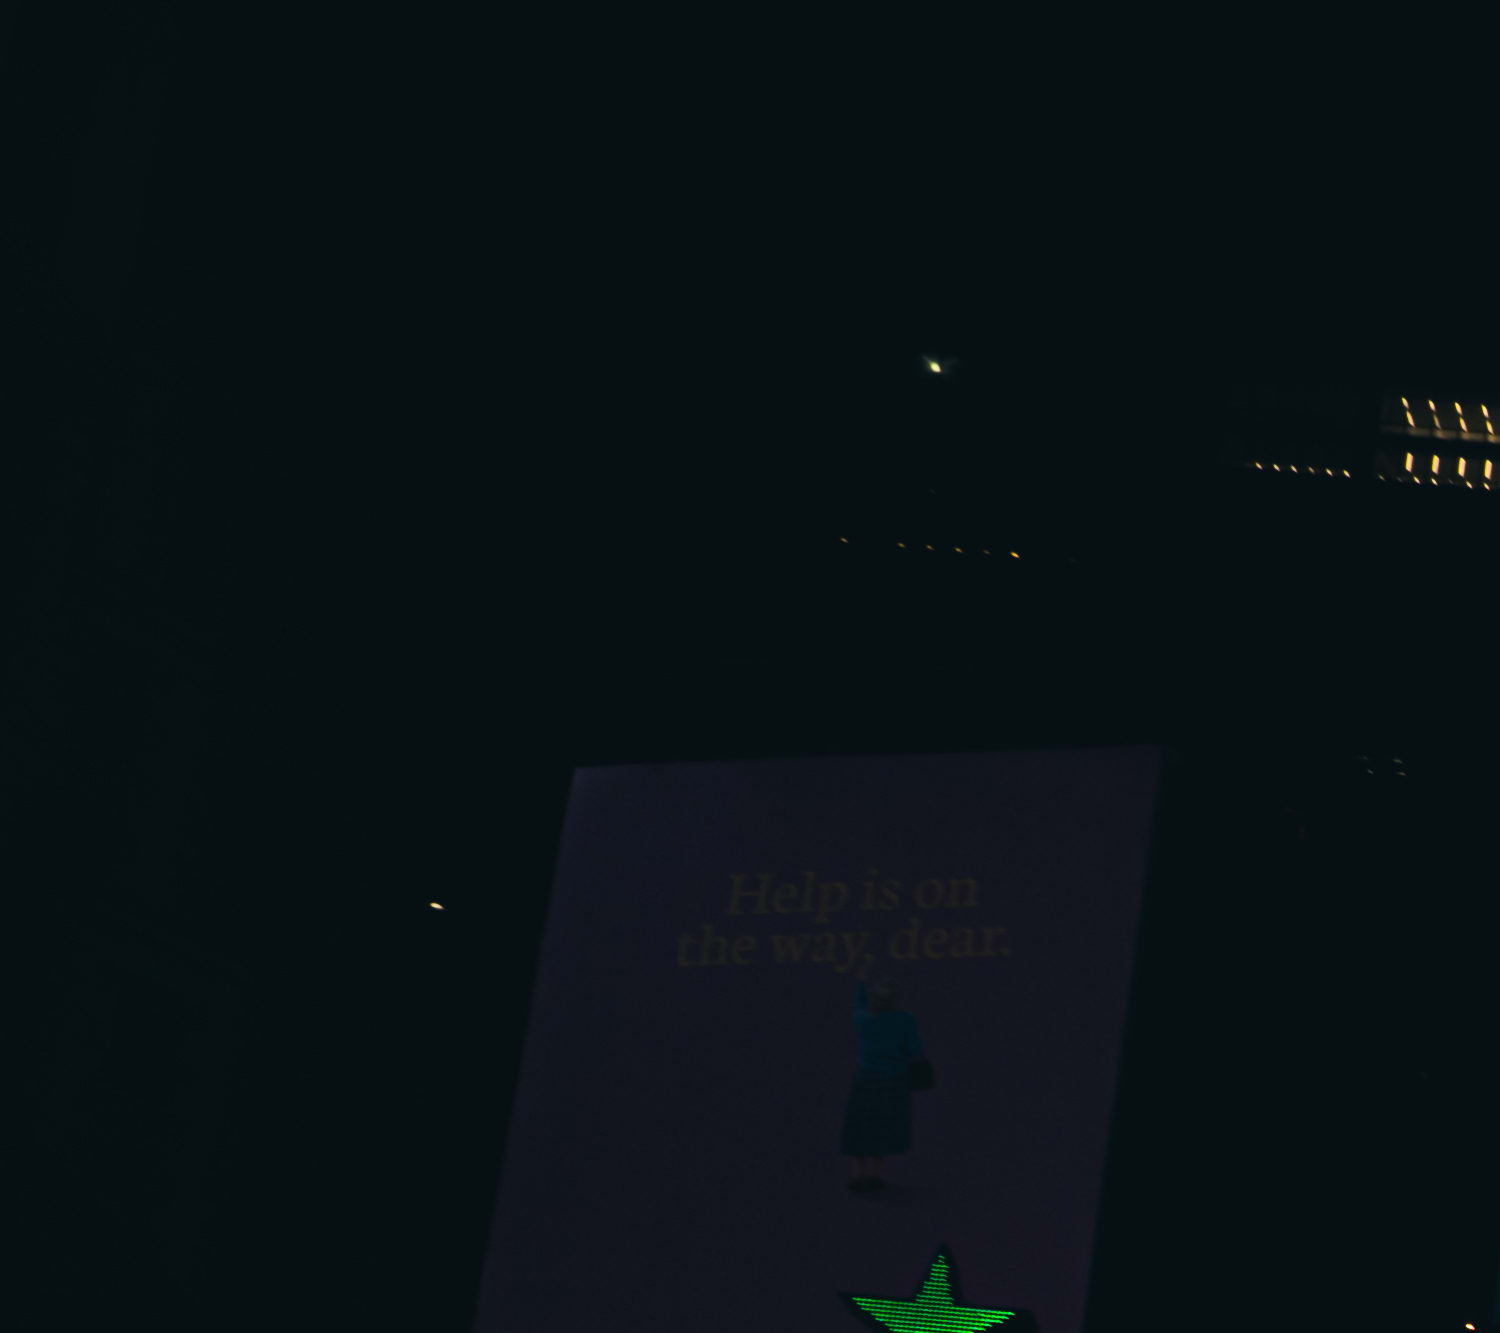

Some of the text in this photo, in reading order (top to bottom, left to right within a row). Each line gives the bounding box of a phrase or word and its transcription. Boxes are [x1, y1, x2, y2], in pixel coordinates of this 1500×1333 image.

[725, 869, 978, 923] Help is on
[676, 926, 755, 967] the
